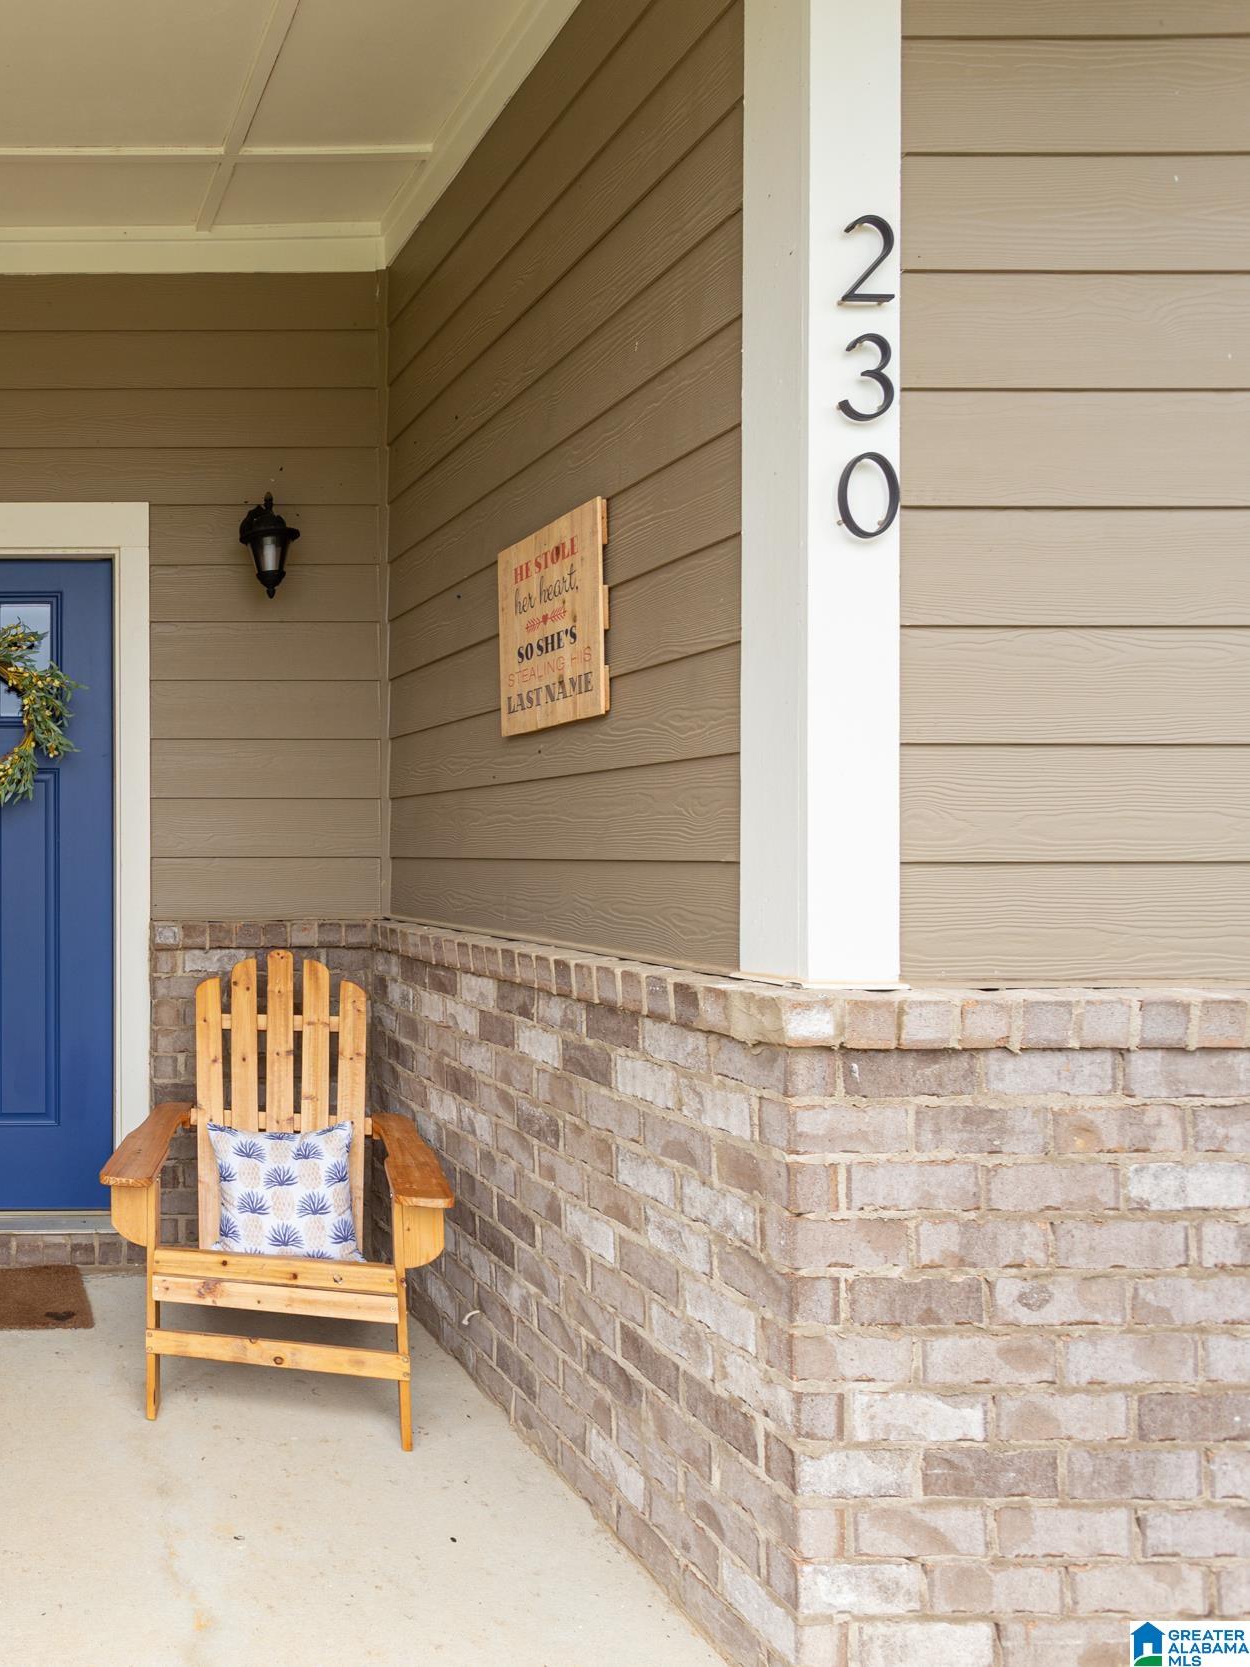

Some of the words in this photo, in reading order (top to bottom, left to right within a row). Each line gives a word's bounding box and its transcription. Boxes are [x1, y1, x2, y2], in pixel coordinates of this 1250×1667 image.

[837, 214, 900, 539] 230
[513, 559, 533, 585] HE
[534, 535, 579, 575] STOLE
[514, 585, 535, 616] her
[517, 642, 534, 663] SO
[536, 625, 578, 657] SHE'S
[508, 656, 565, 688] STEALING
[570, 647, 592, 669] HIS
[506, 687, 543, 714] LAST
[544, 671, 594, 703] NAME
